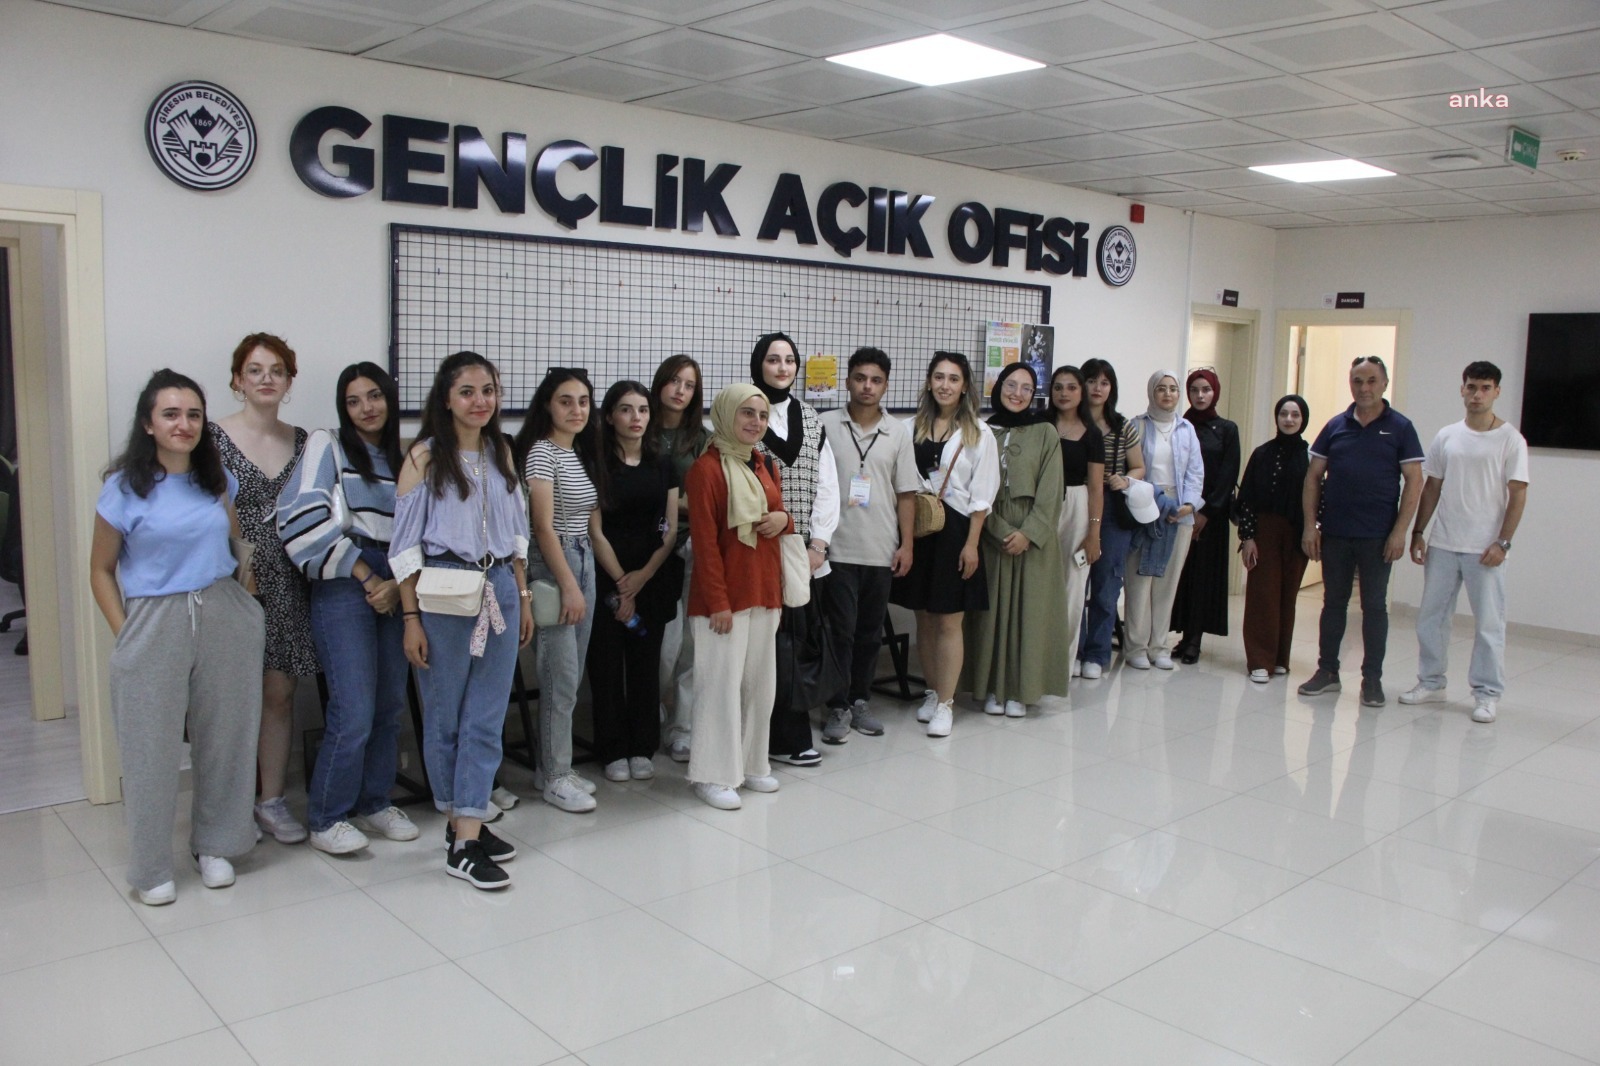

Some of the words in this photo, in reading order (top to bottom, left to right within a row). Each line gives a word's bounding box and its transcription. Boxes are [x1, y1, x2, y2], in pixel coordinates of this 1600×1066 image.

[159, 91, 193, 124] GİRESUN
[195, 91, 246, 131] BELEDİYESİ
[193, 118, 213, 127] 1869
[289, 105, 742, 236] GENÇLİK
[756, 173, 936, 258] AÇIK
[948, 202, 1090, 277] OFİSİ
